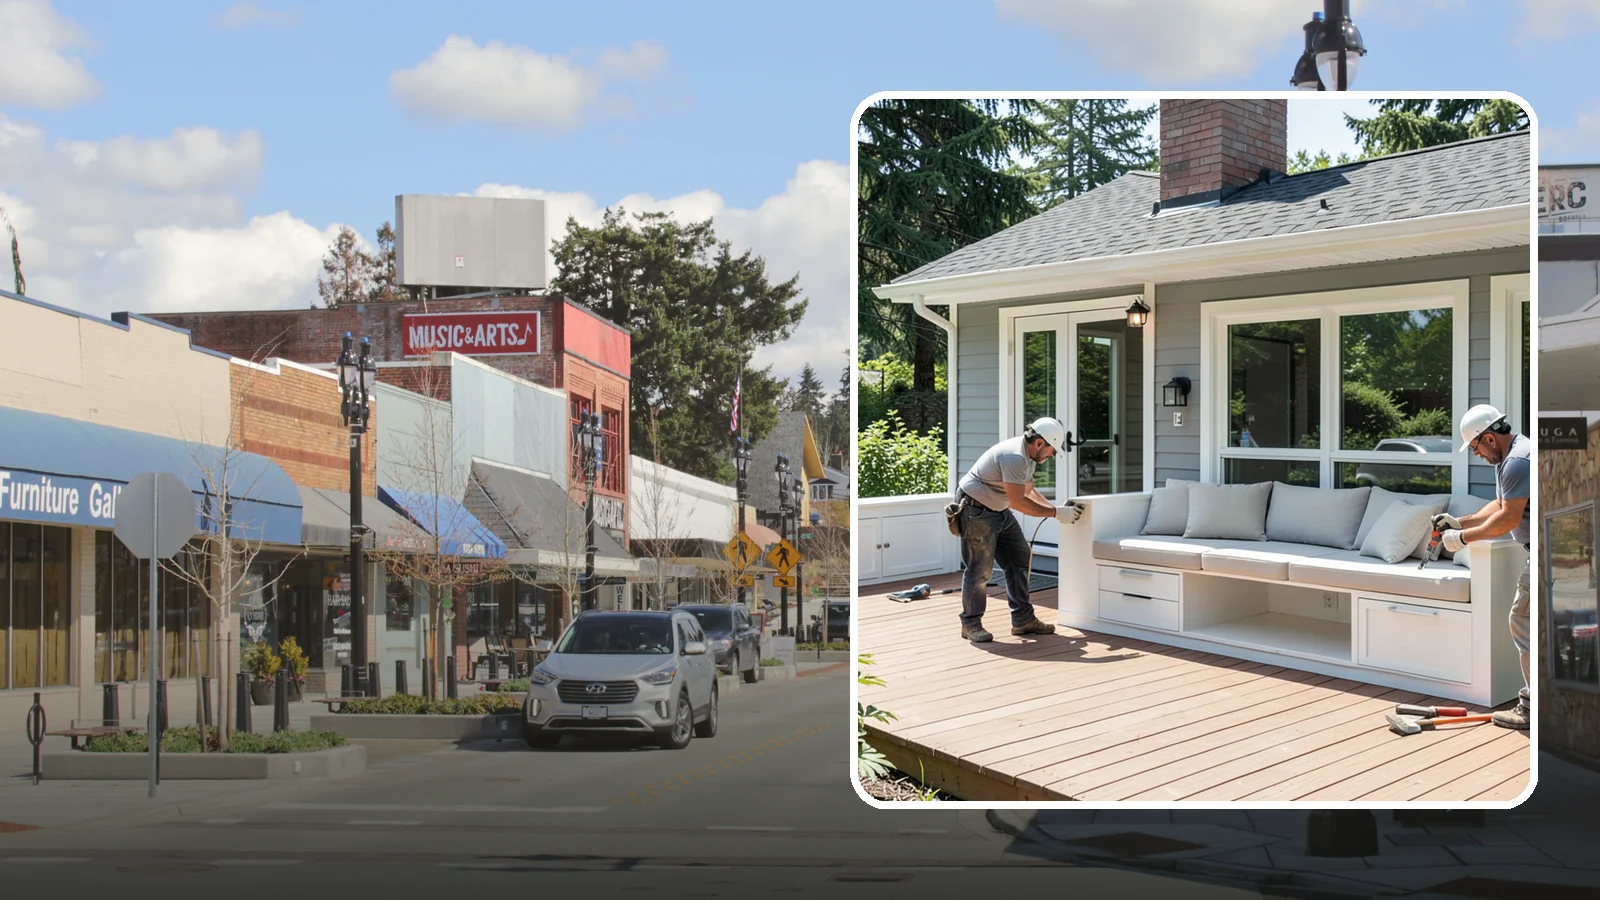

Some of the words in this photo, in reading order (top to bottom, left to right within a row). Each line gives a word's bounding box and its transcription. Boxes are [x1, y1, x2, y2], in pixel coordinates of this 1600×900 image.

[409, 322, 519, 348] MUSIC&ARTS
[1541, 428, 1577, 436] UGA
[0, 470, 79, 515] Furniture
[89, 482, 121, 519] Gal
[454, 563, 479, 574] SUSHI
